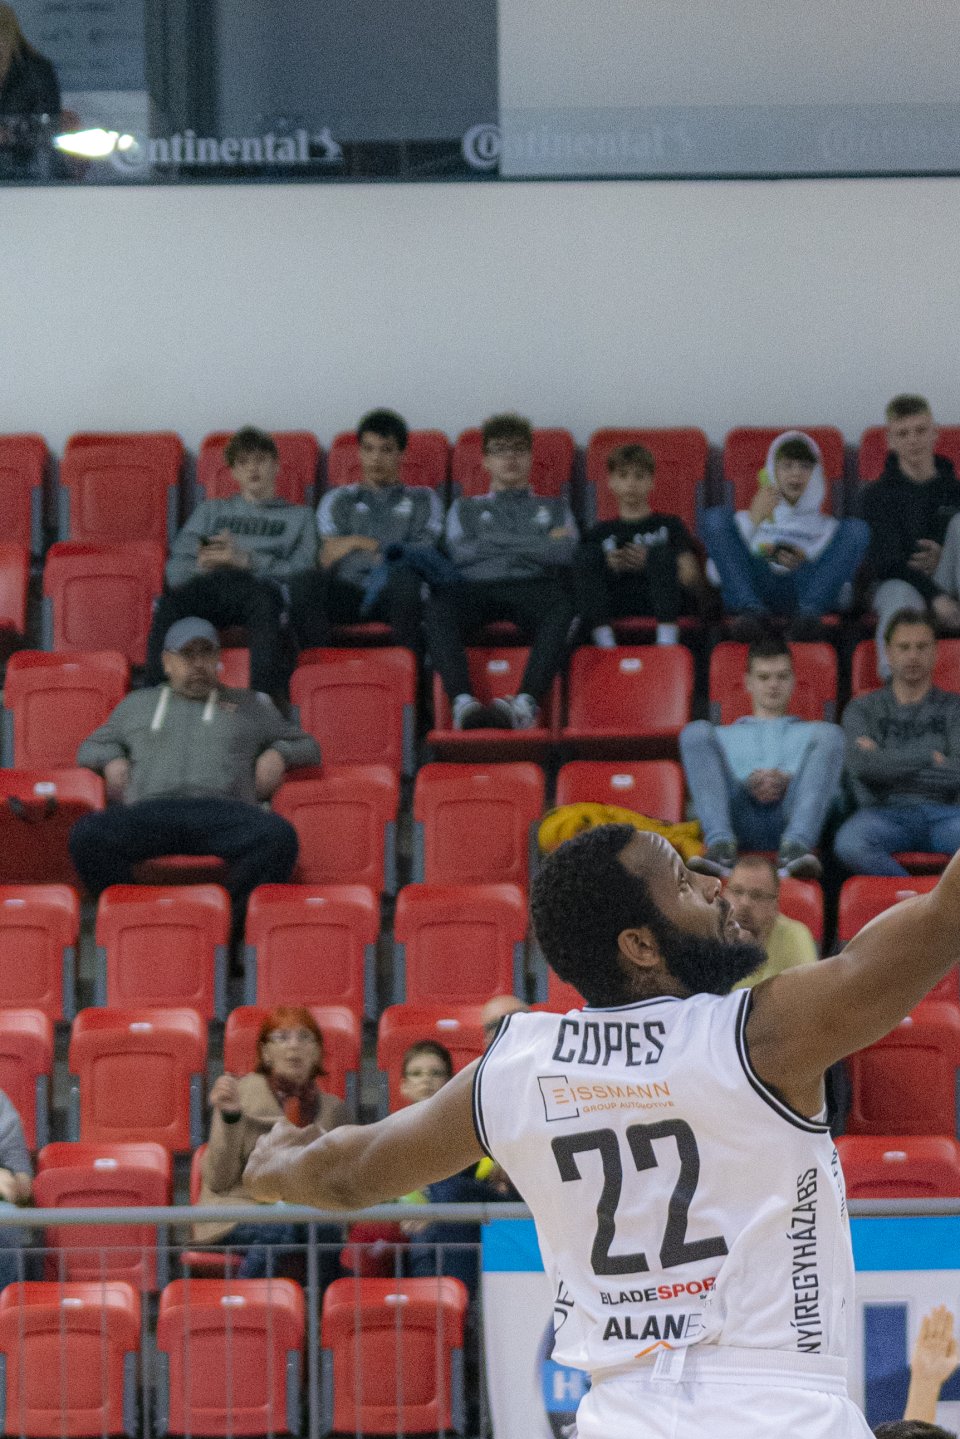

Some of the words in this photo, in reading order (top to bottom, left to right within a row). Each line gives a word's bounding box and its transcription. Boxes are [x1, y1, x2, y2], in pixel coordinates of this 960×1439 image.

[552, 1018, 666, 1067] COPES
[552, 1080, 671, 1105] EISSMANN
[582, 1102, 617, 1113] GROUP
[551, 1118, 729, 1276] 22
